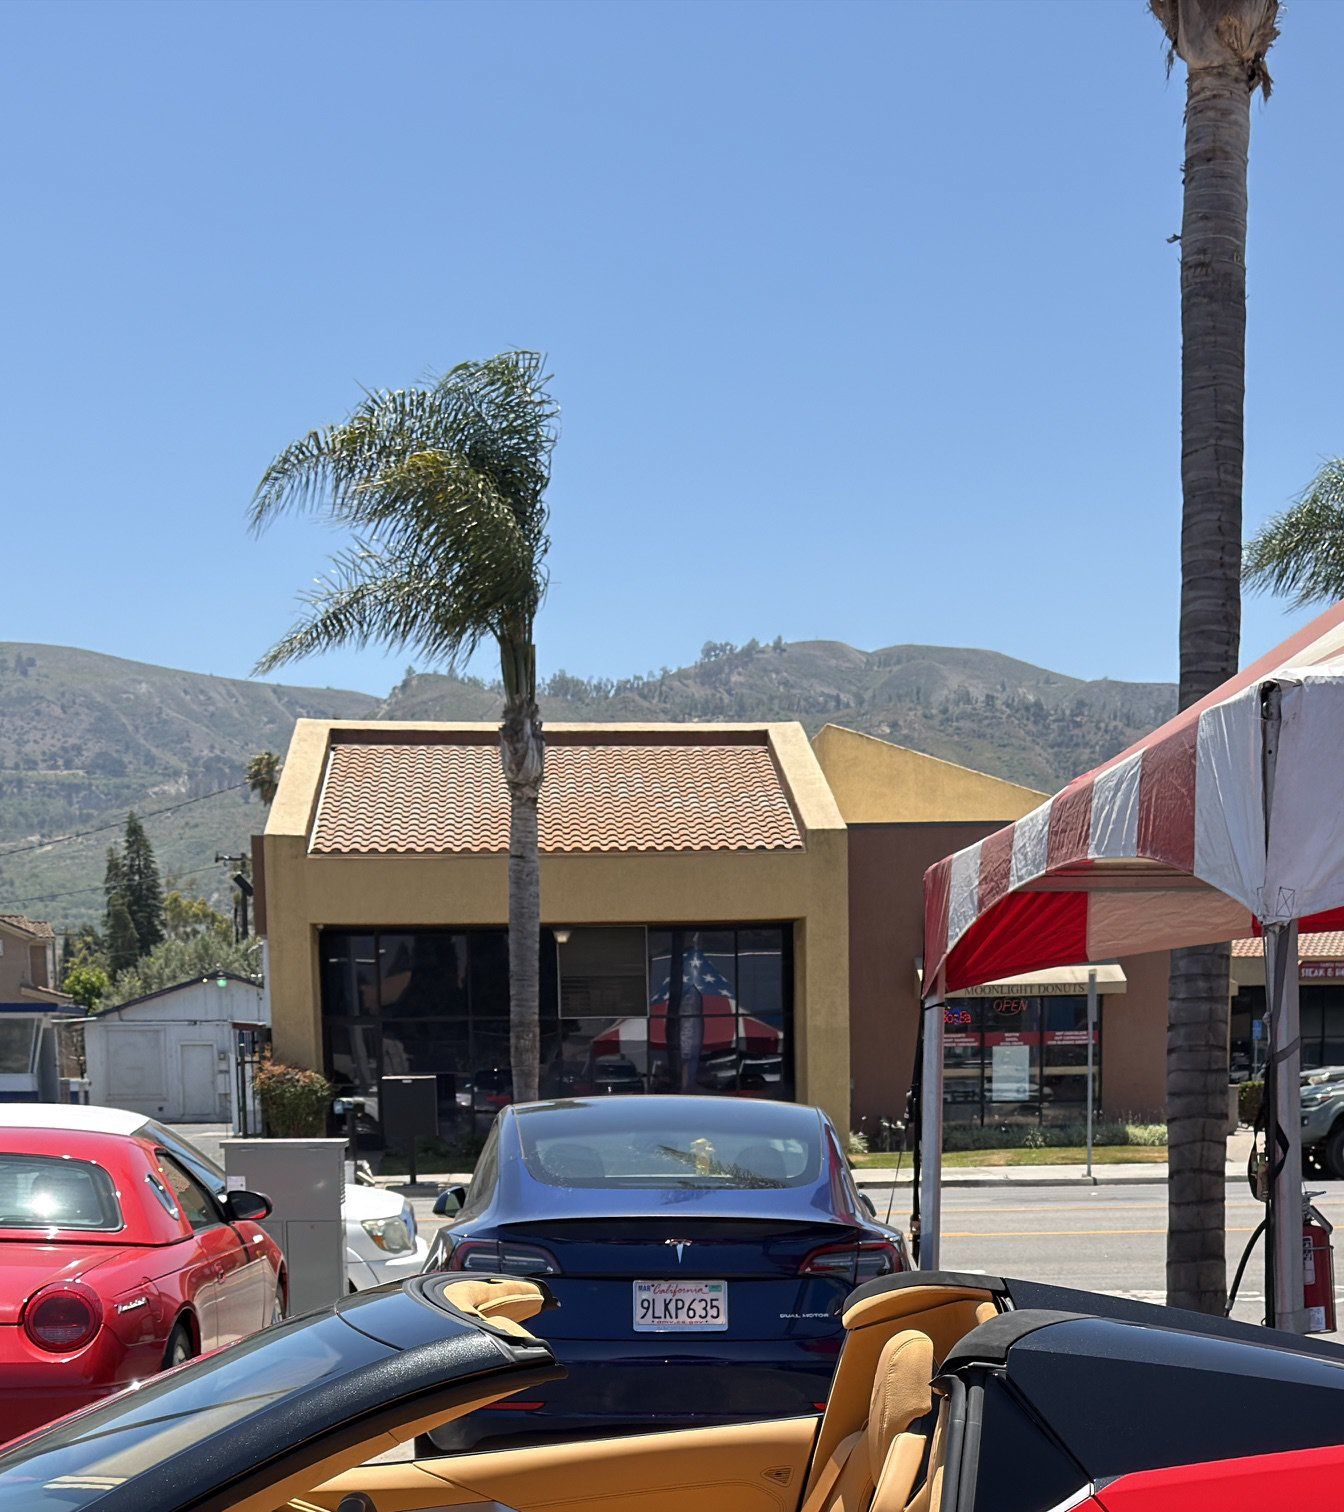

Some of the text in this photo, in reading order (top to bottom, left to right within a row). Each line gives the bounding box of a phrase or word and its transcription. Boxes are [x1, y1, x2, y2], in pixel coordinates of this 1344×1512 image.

[964, 984, 1085, 996] MOONLIGHT DONUTS
[993, 1000, 1028, 1011] OPEN
[652, 1283, 709, 1297] California
[640, 1298, 720, 1319] 9LKP635
